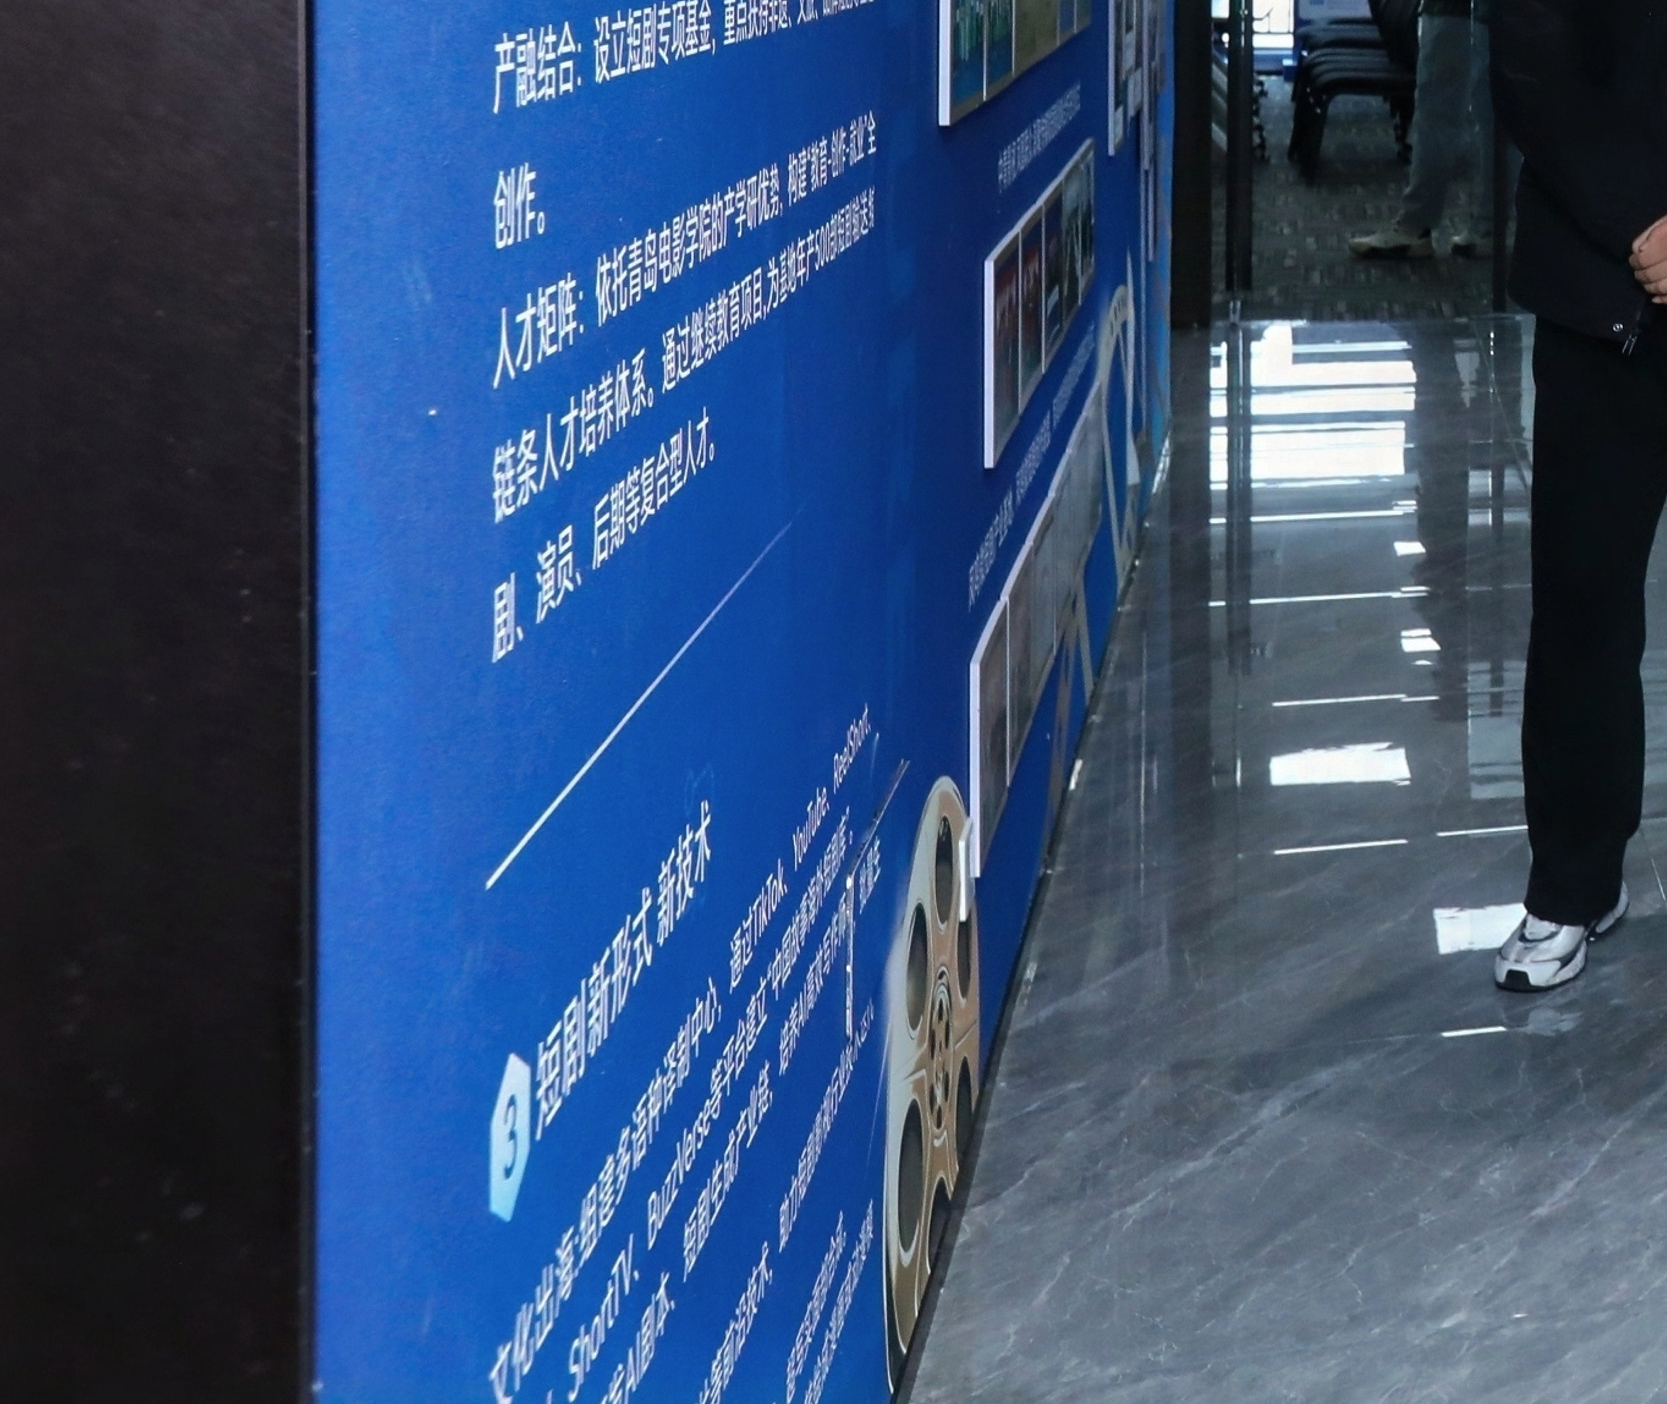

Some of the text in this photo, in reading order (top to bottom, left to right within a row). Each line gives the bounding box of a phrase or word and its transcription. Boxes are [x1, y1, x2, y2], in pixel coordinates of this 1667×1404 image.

[493, 162, 545, 249] 创作。
[502, 800, 711, 1181] 3 短剧新形式 新技术
